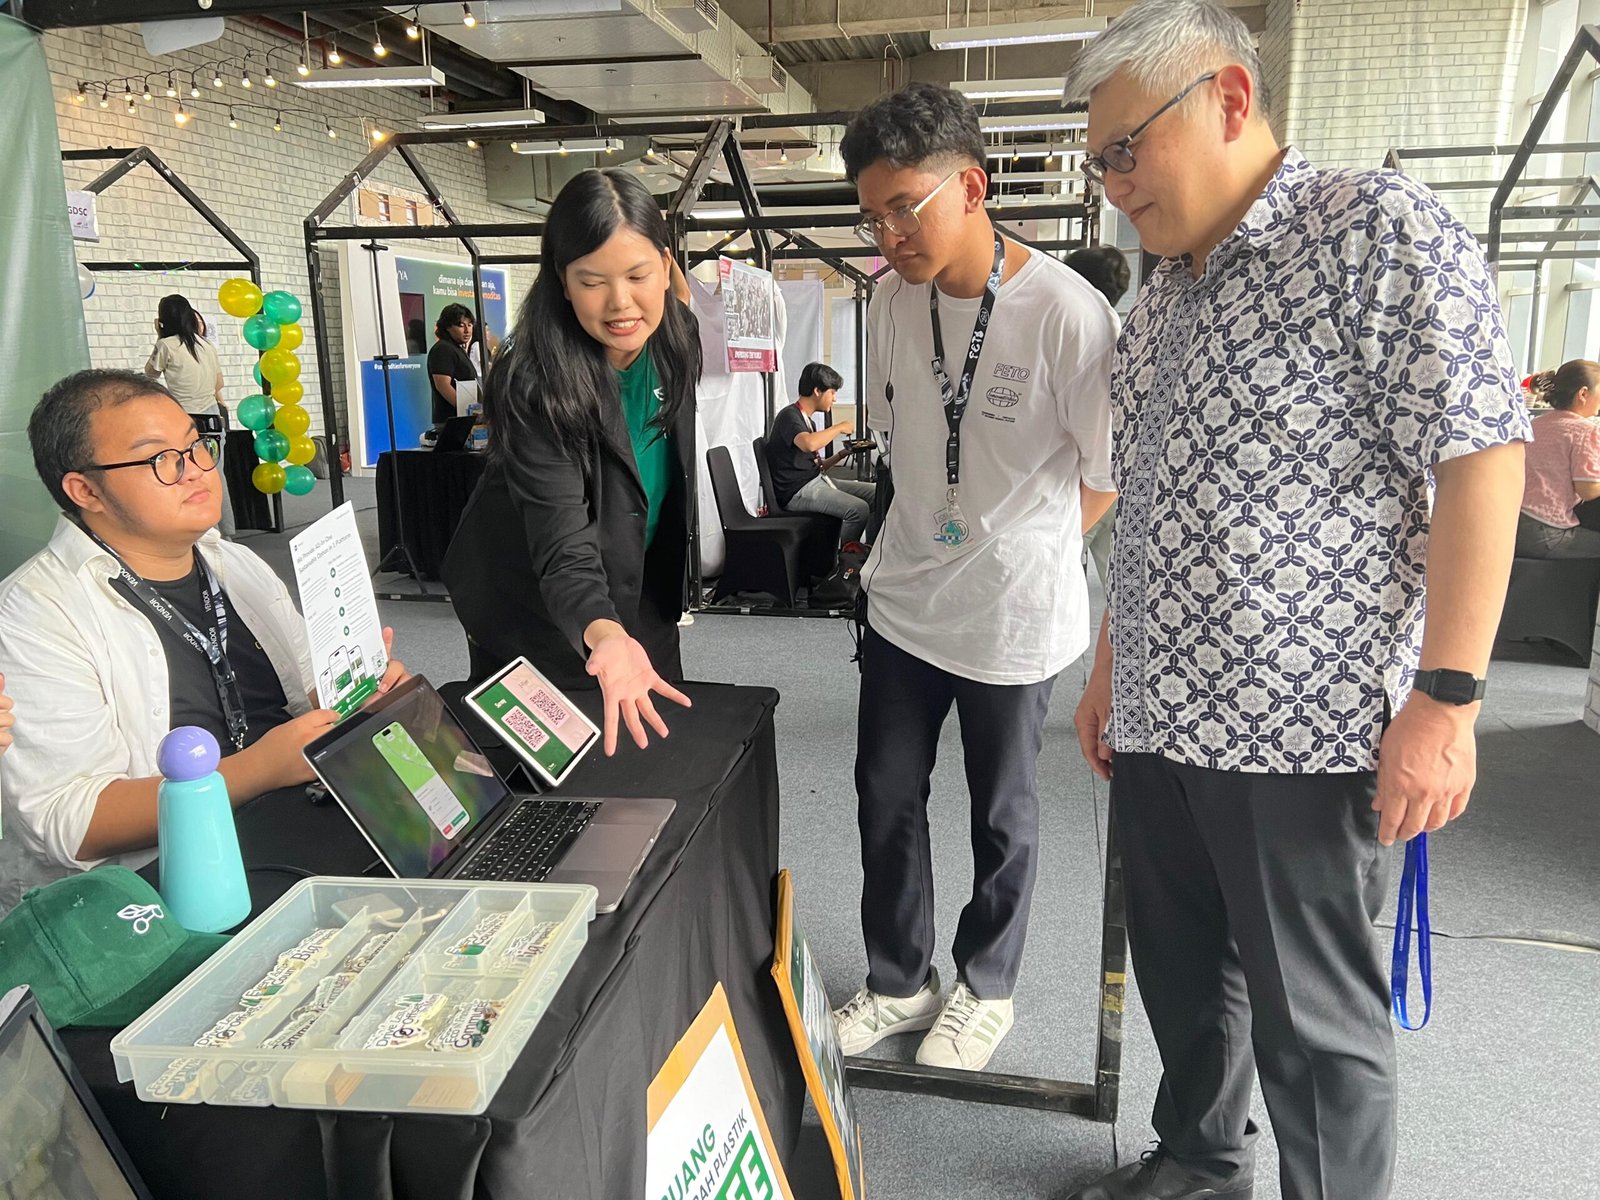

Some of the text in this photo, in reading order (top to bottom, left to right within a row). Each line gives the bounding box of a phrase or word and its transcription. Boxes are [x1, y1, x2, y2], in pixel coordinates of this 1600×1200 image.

[68, 206, 88, 216] GDSC
[994, 363, 1030, 380] FETO
[120, 567, 139, 587] VENDO
[149, 597, 173, 622] VENDOR
[713, 1108, 748, 1179] PLASTIK
